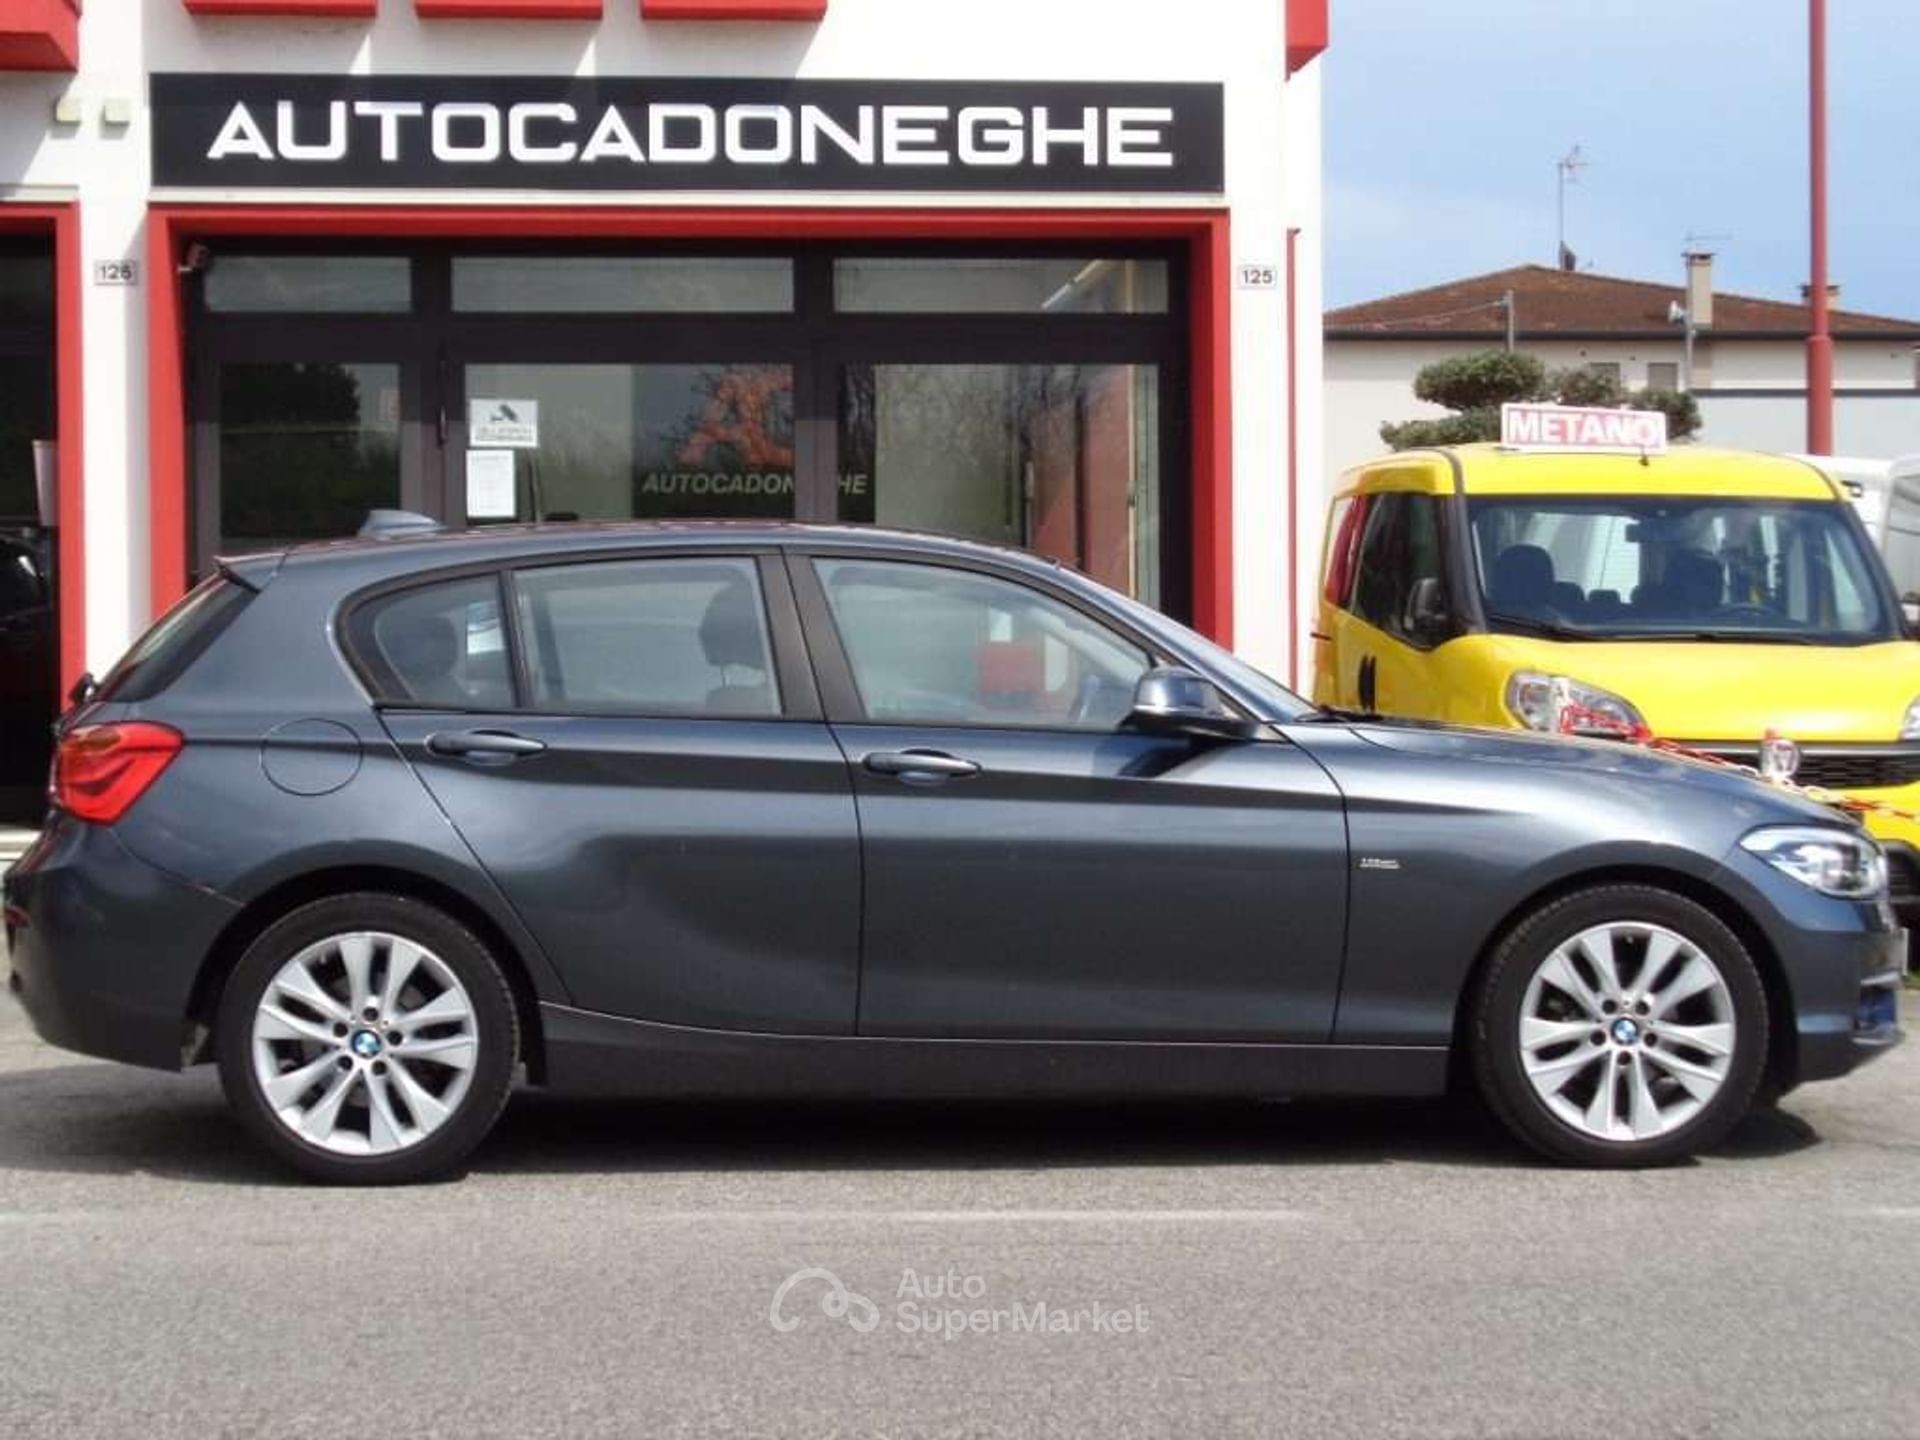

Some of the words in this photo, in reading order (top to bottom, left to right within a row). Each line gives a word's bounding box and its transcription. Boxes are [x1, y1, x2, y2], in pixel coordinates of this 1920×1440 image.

[206, 100, 1174, 168] AUTOCADONEGHE
[1241, 269, 1272, 284] 125
[1508, 410, 1662, 447] METANO
